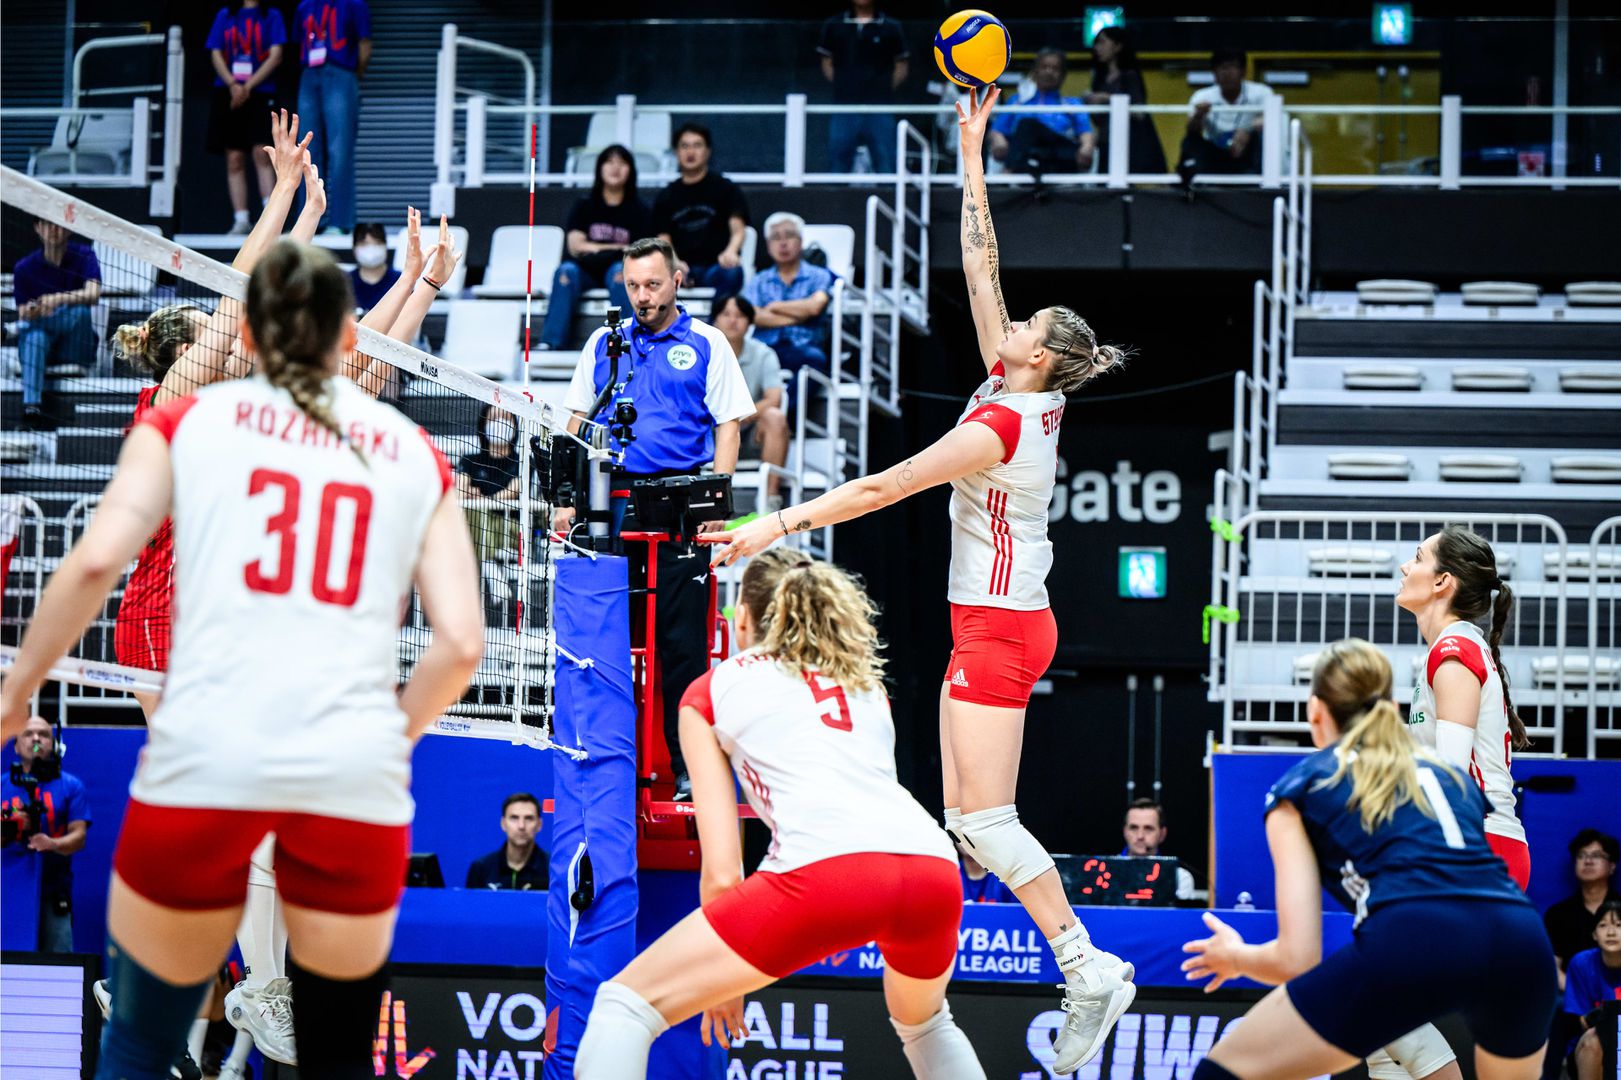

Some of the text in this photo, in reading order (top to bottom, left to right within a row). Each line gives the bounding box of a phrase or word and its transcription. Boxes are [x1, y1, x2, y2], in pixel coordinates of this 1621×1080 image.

[243, 466, 374, 608] 30
[800, 667, 853, 732] 5
[957, 927, 1042, 953] YBALL
[960, 954, 1041, 974] LEAGUE
[456, 991, 546, 1041] VO
[729, 1001, 844, 1052] ALL
[456, 1049, 544, 1080] NAT
